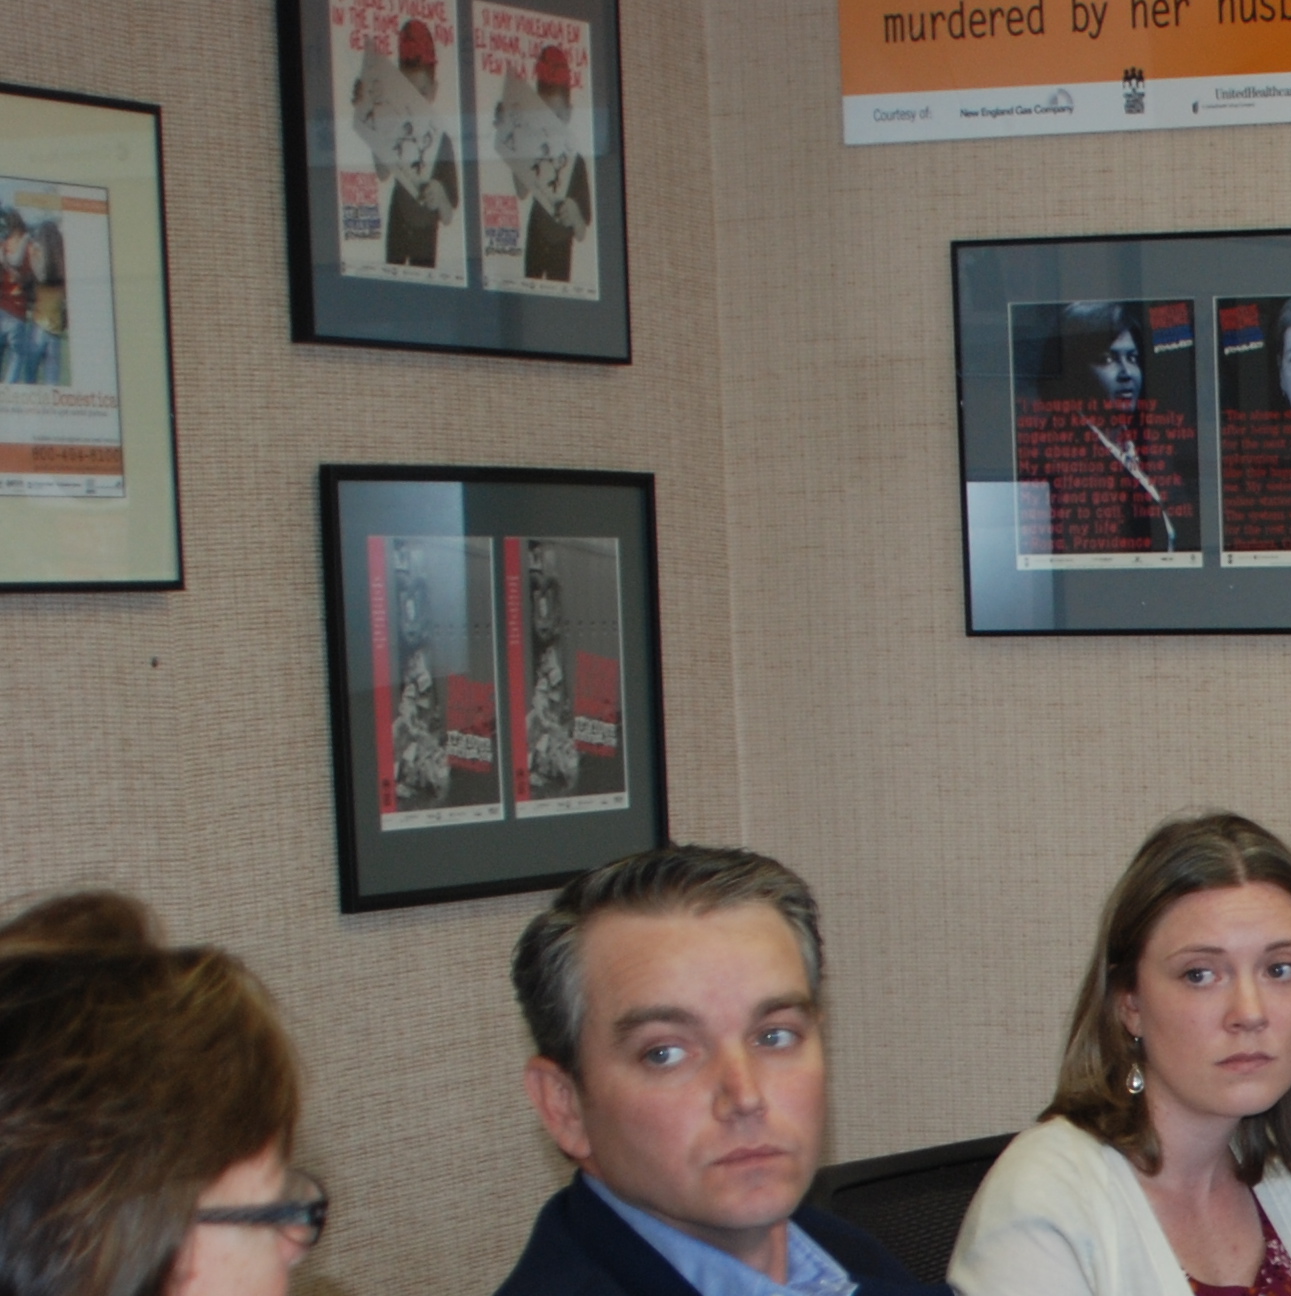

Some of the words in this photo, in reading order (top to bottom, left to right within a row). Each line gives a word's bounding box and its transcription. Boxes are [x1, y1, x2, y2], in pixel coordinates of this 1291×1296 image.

[883, 0, 1046, 43] murdered
[1071, 0, 1107, 39] by
[1131, 0, 1190, 28] her
[873, 109, 916, 123] Courtesy
[919, 106, 932, 120] of:
[960, 108, 979, 118] New
[980, 107, 1014, 119] England
[1015, 106, 1032, 116] Gas
[1034, 103, 1074, 117] Company
